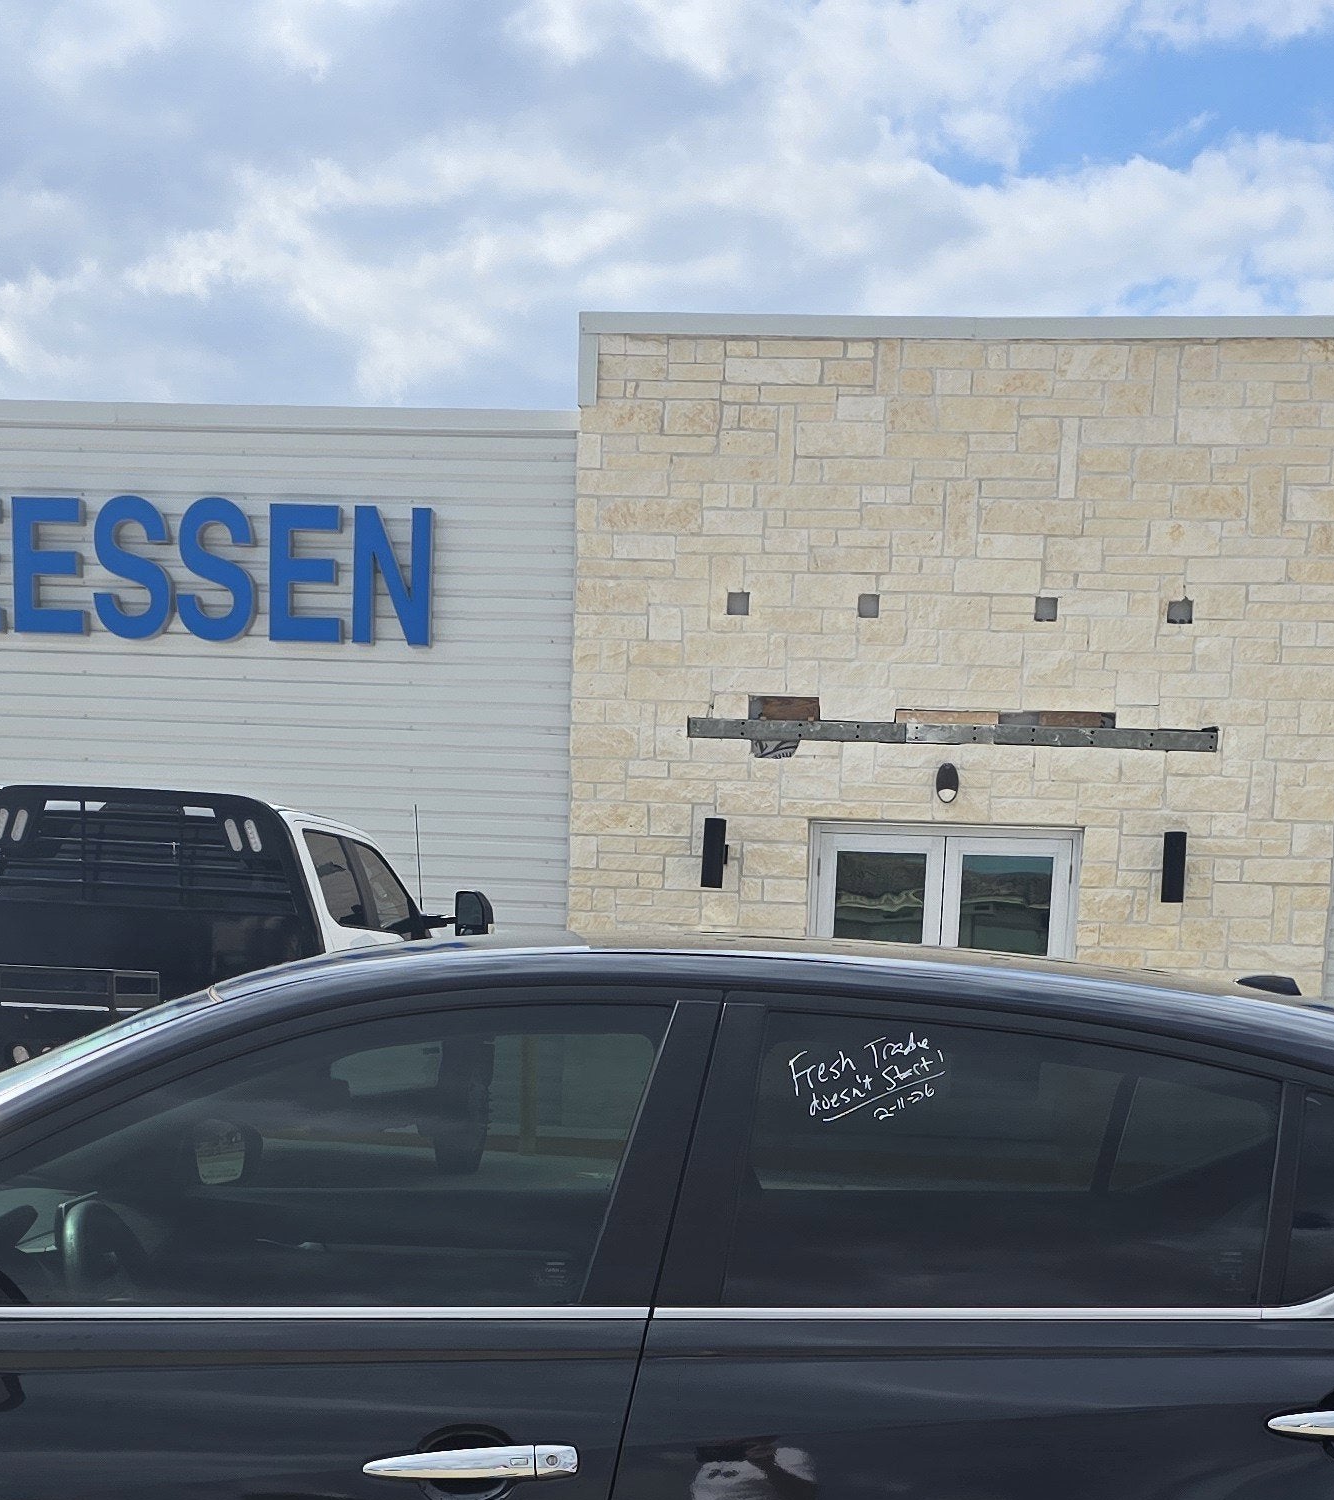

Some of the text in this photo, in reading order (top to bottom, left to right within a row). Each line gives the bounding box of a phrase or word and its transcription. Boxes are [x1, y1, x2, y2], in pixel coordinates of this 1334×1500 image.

[788, 1031, 930, 1097] Fresh Trade
[809, 1074, 873, 1117] doesn't
